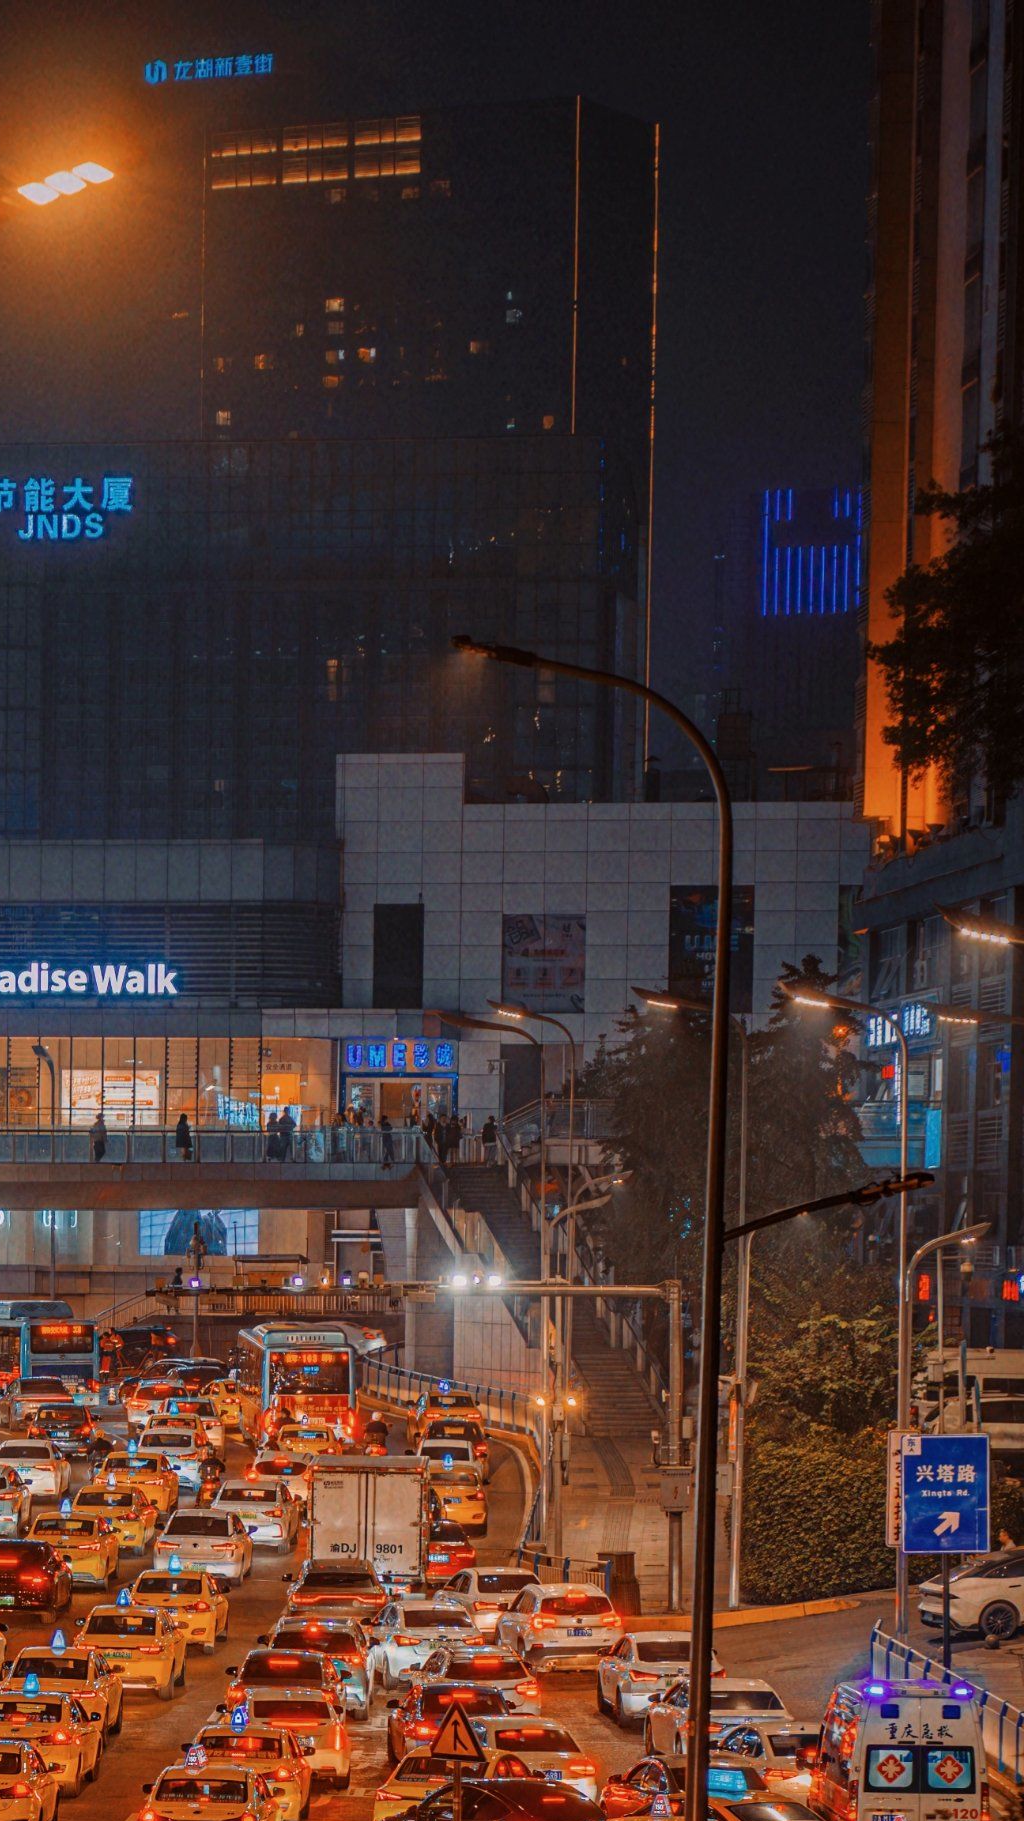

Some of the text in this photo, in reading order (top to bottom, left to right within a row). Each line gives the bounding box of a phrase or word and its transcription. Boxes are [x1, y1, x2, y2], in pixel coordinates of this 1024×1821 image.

[173, 53, 273, 81] 龙湖新壹街
[17, 512, 104, 540] JNDS
[91, 963, 178, 994] Walk
[916, 1464, 976, 1483] 兴塔路
[956, 1489, 971, 1497] Rd.
[376, 1544, 403, 1554] 9801
[884, 1722, 954, 1740] 重庆急救
[953, 1808, 978, 1820] 120
